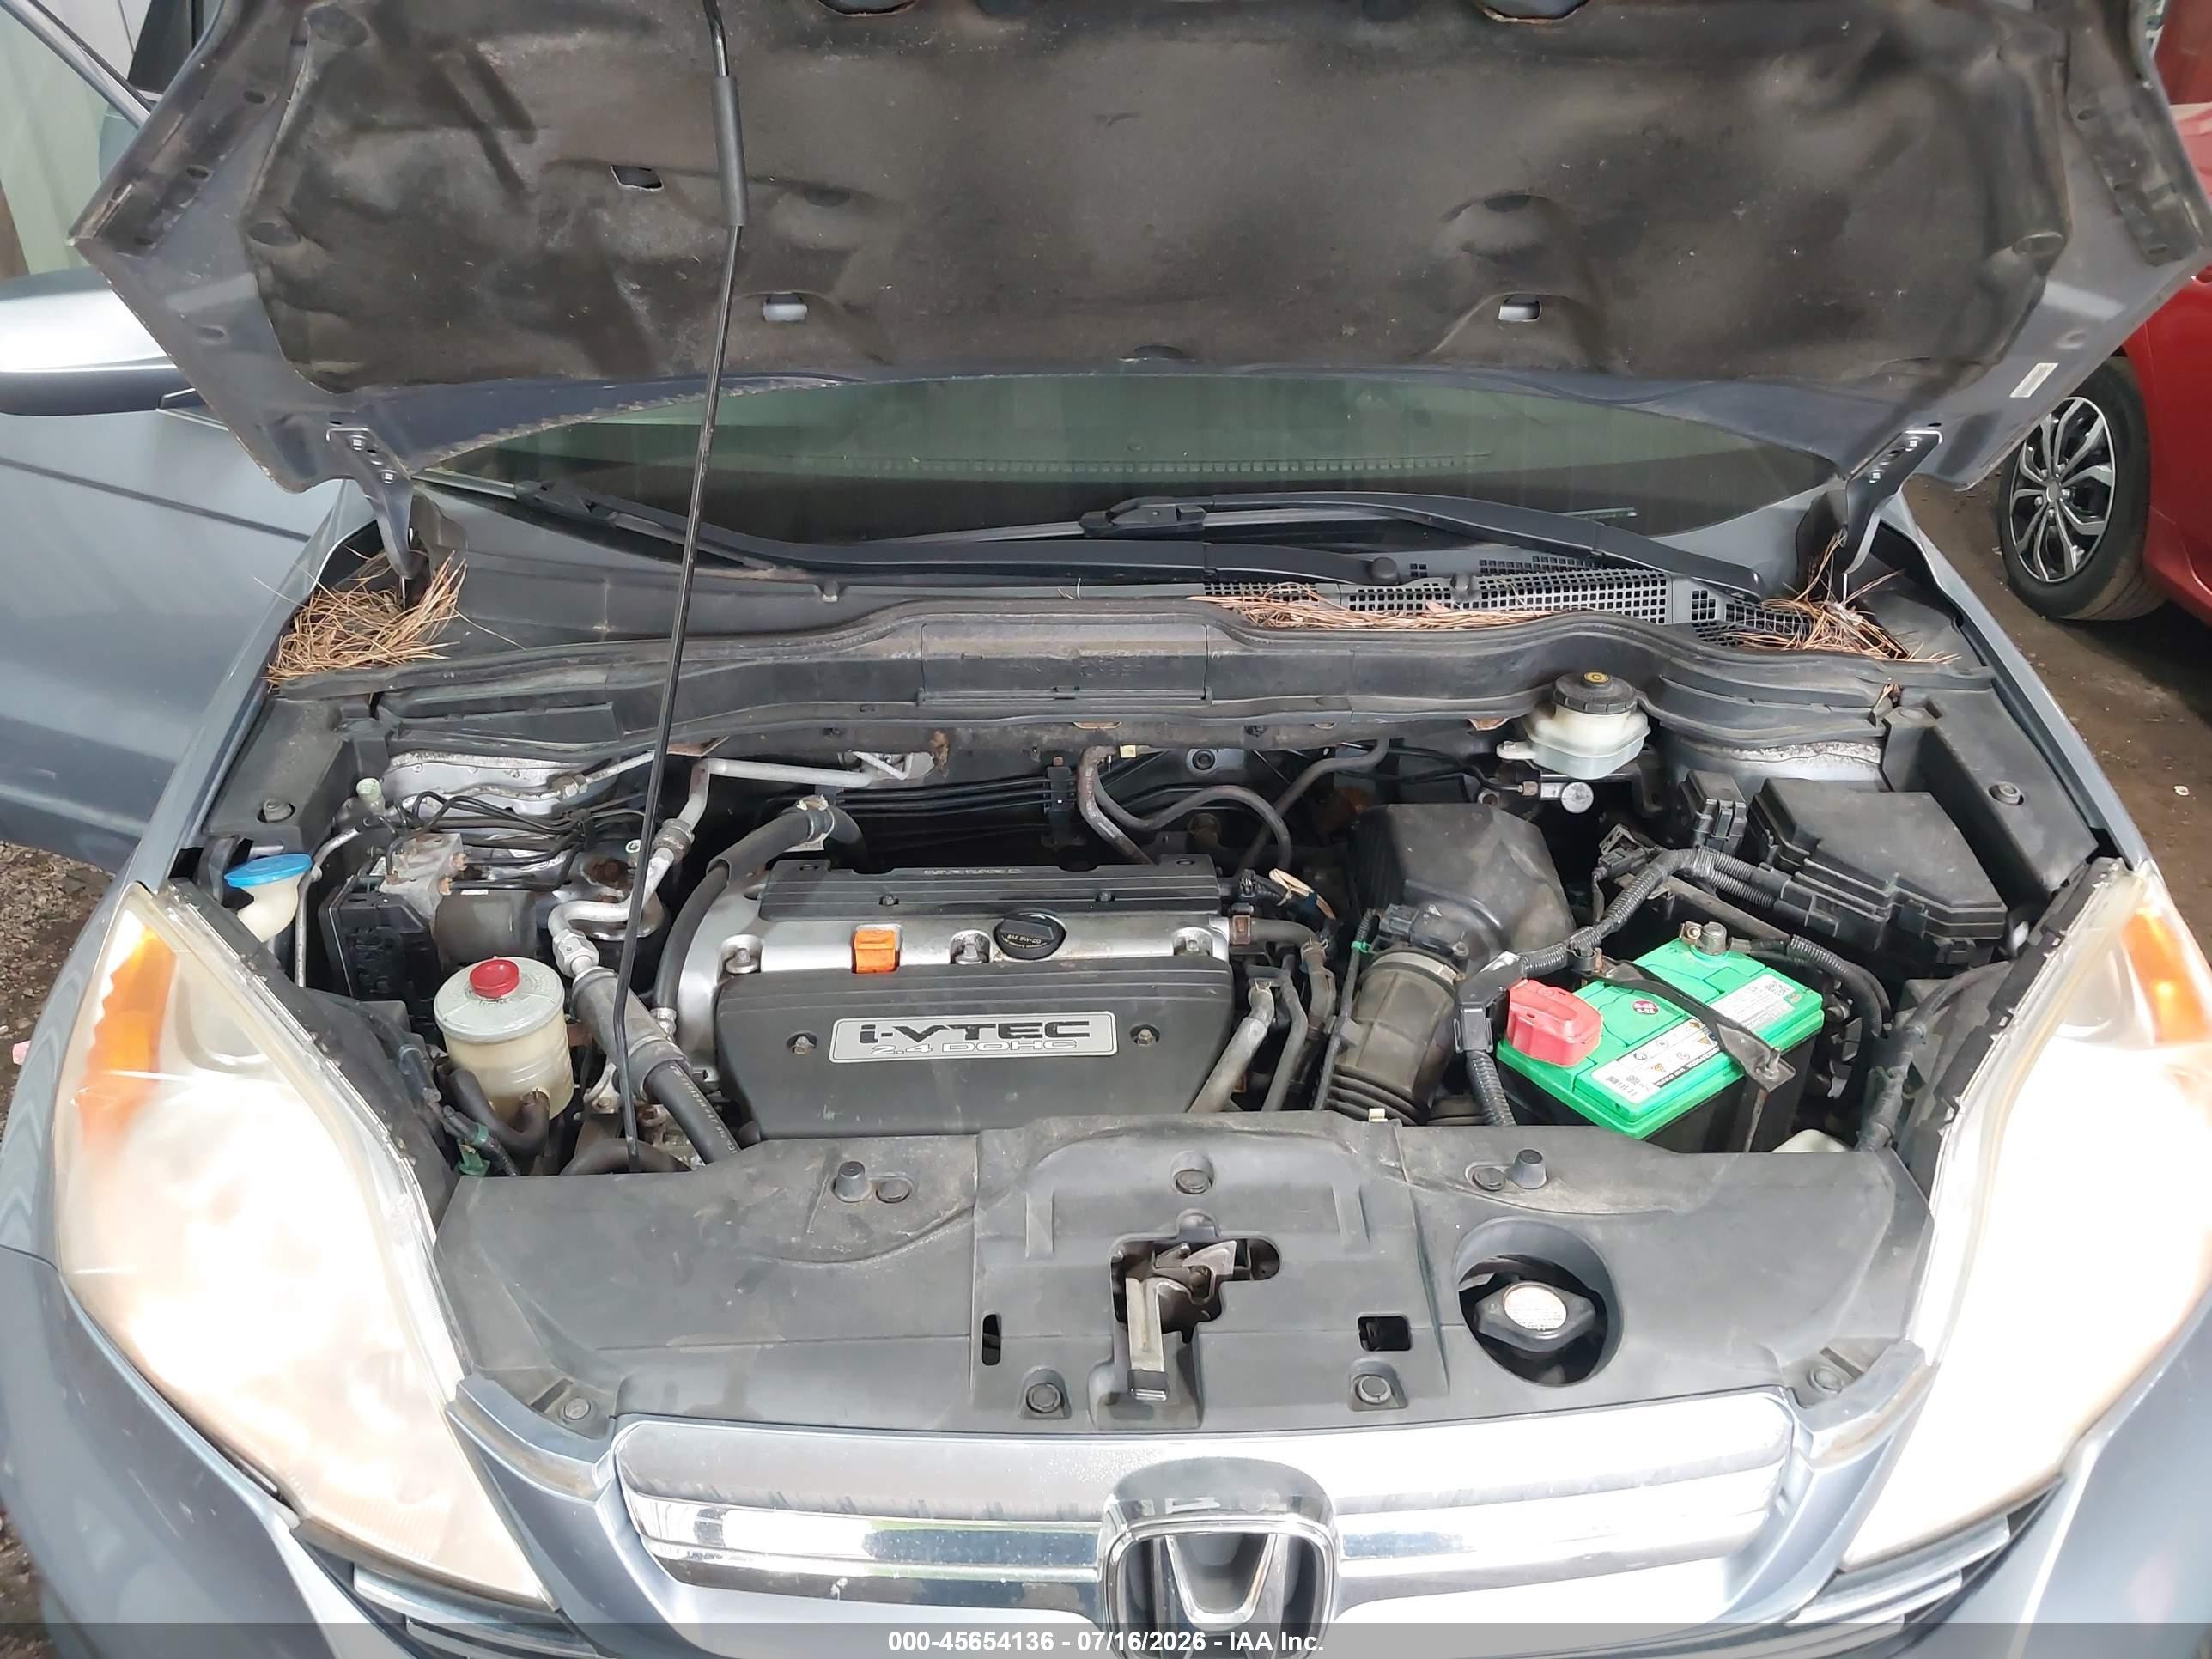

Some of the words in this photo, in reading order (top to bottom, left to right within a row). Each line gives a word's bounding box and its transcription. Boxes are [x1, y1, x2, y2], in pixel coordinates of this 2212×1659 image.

[859, 1020, 1089, 1043] i-VTEC
[871, 1043, 933, 1055] 2.4
[942, 1039, 1077, 1053] DOHC
